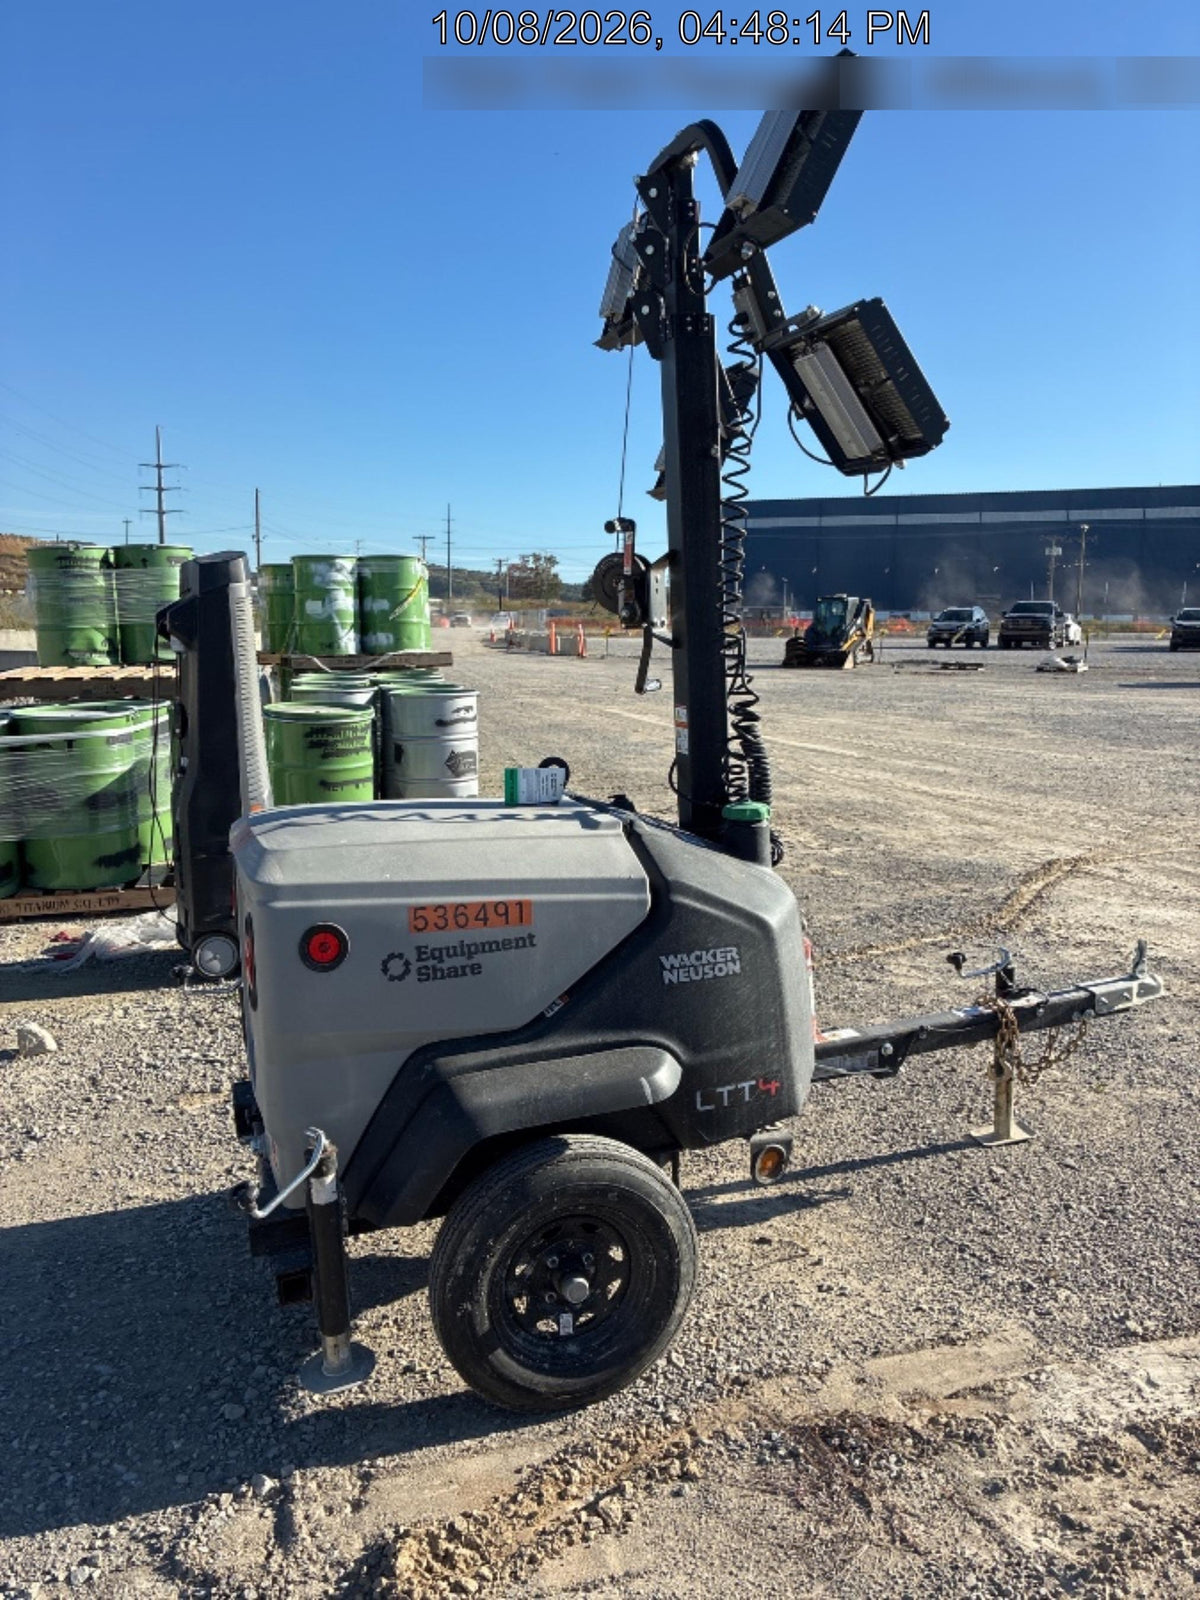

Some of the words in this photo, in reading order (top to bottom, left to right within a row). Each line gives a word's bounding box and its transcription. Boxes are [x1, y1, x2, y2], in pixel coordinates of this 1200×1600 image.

[413, 902, 524, 932] 536491
[415, 933, 537, 963] Equipment
[659, 947, 740, 969] WACKER
[416, 962, 483, 983] Share
[662, 960, 741, 984] NEUSON
